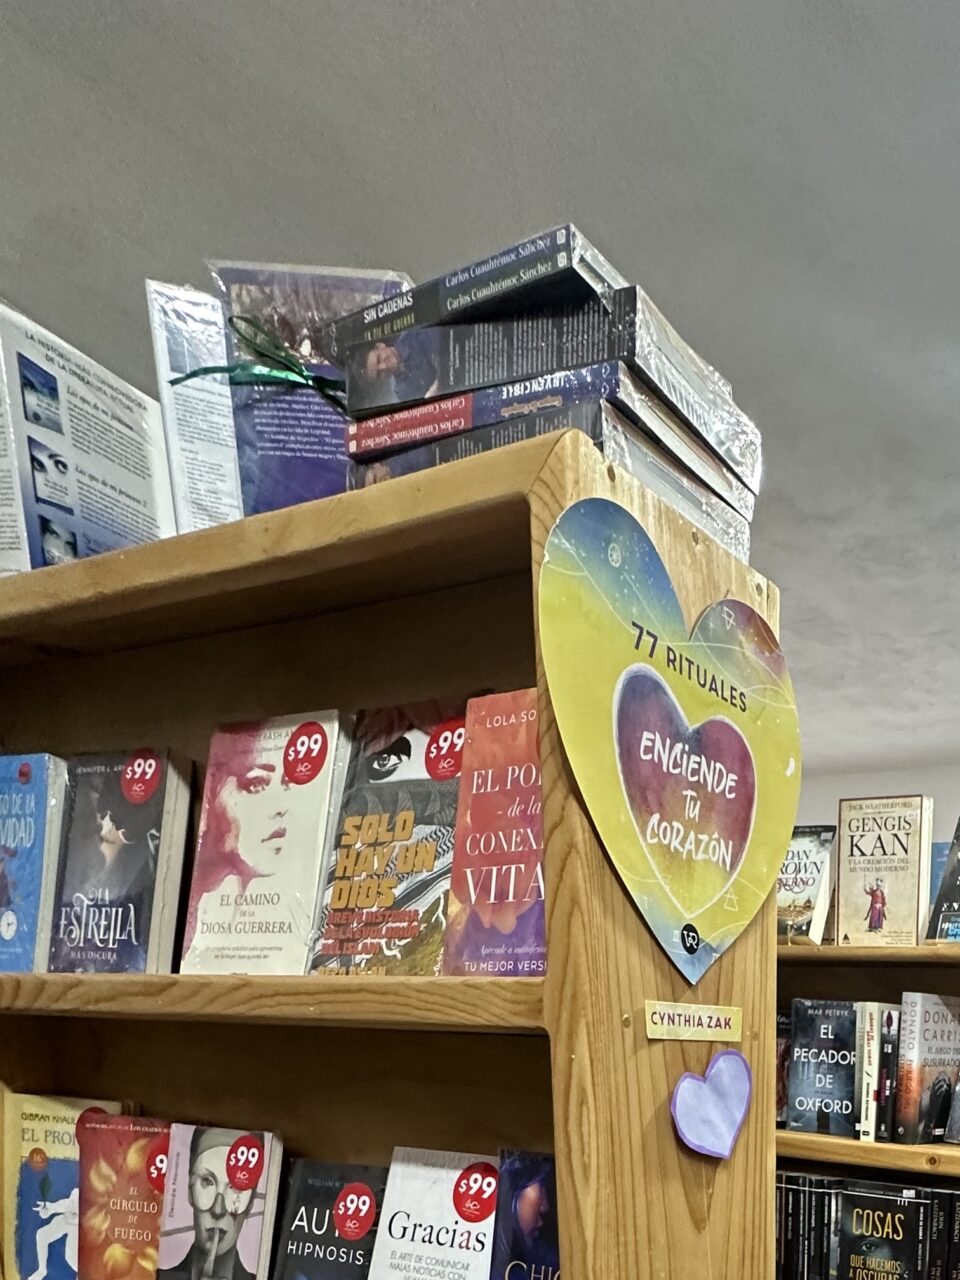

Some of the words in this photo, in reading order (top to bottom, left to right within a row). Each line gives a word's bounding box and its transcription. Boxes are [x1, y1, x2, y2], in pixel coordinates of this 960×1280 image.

[364, 309, 376, 323] SIN
[378, 293, 413, 317] CADENAS
[632, 621, 658, 660] 77
[666, 645, 748, 714] RITUALES
[486, 710, 516, 728] LOLA
[287, 733, 322, 761] $99
[429, 728, 466, 759] $99
[126, 758, 156, 779] $99
[471, 767, 500, 794] EL
[507, 797, 525, 818] de
[341, 810, 416, 846] SOLO
[848, 816, 911, 833] GENGIS
[848, 833, 911, 857] KAN
[335, 844, 392, 877] HAY
[395, 840, 437, 874] UN
[219, 894, 232, 907] EL
[234, 893, 280, 906] CAMINO
[330, 877, 399, 910] DIOS
[201, 922, 232, 935] DIOSA
[234, 921, 292, 935] GUERRERA
[464, 961, 476, 972] TU
[480, 961, 514, 971] MEJOR
[651, 1012, 704, 1028] CYNTHIA
[707, 1016, 731, 1029] ZAK
[820, 1025, 834, 1039] EL
[794, 1048, 856, 1065] PECADOR
[816, 1074, 833, 1088] DE
[795, 1097, 852, 1114] OXFORD
[21, 1112, 50, 1123] GIBRAN
[21, 1128, 38, 1143] EL
[229, 1146, 259, 1169] $99
[129, 1187, 139, 1195] EL
[458, 1173, 497, 1199] $99
[338, 1194, 370, 1217] $99
[128, 1215, 138, 1224] DE
[852, 1208, 905, 1240] COSAS
[114, 1228, 151, 1242] FUEGO
[387, 1210, 487, 1253] Gracias
[287, 1240, 365, 1266] HIPNOSIS
[412, 1265, 446, 1280] NOTICIAS
[425, 1256, 470, 1272] COMUNICAR
[850, 1254, 865, 1268] QUE
[866, 1255, 901, 1274] HACEMOS
